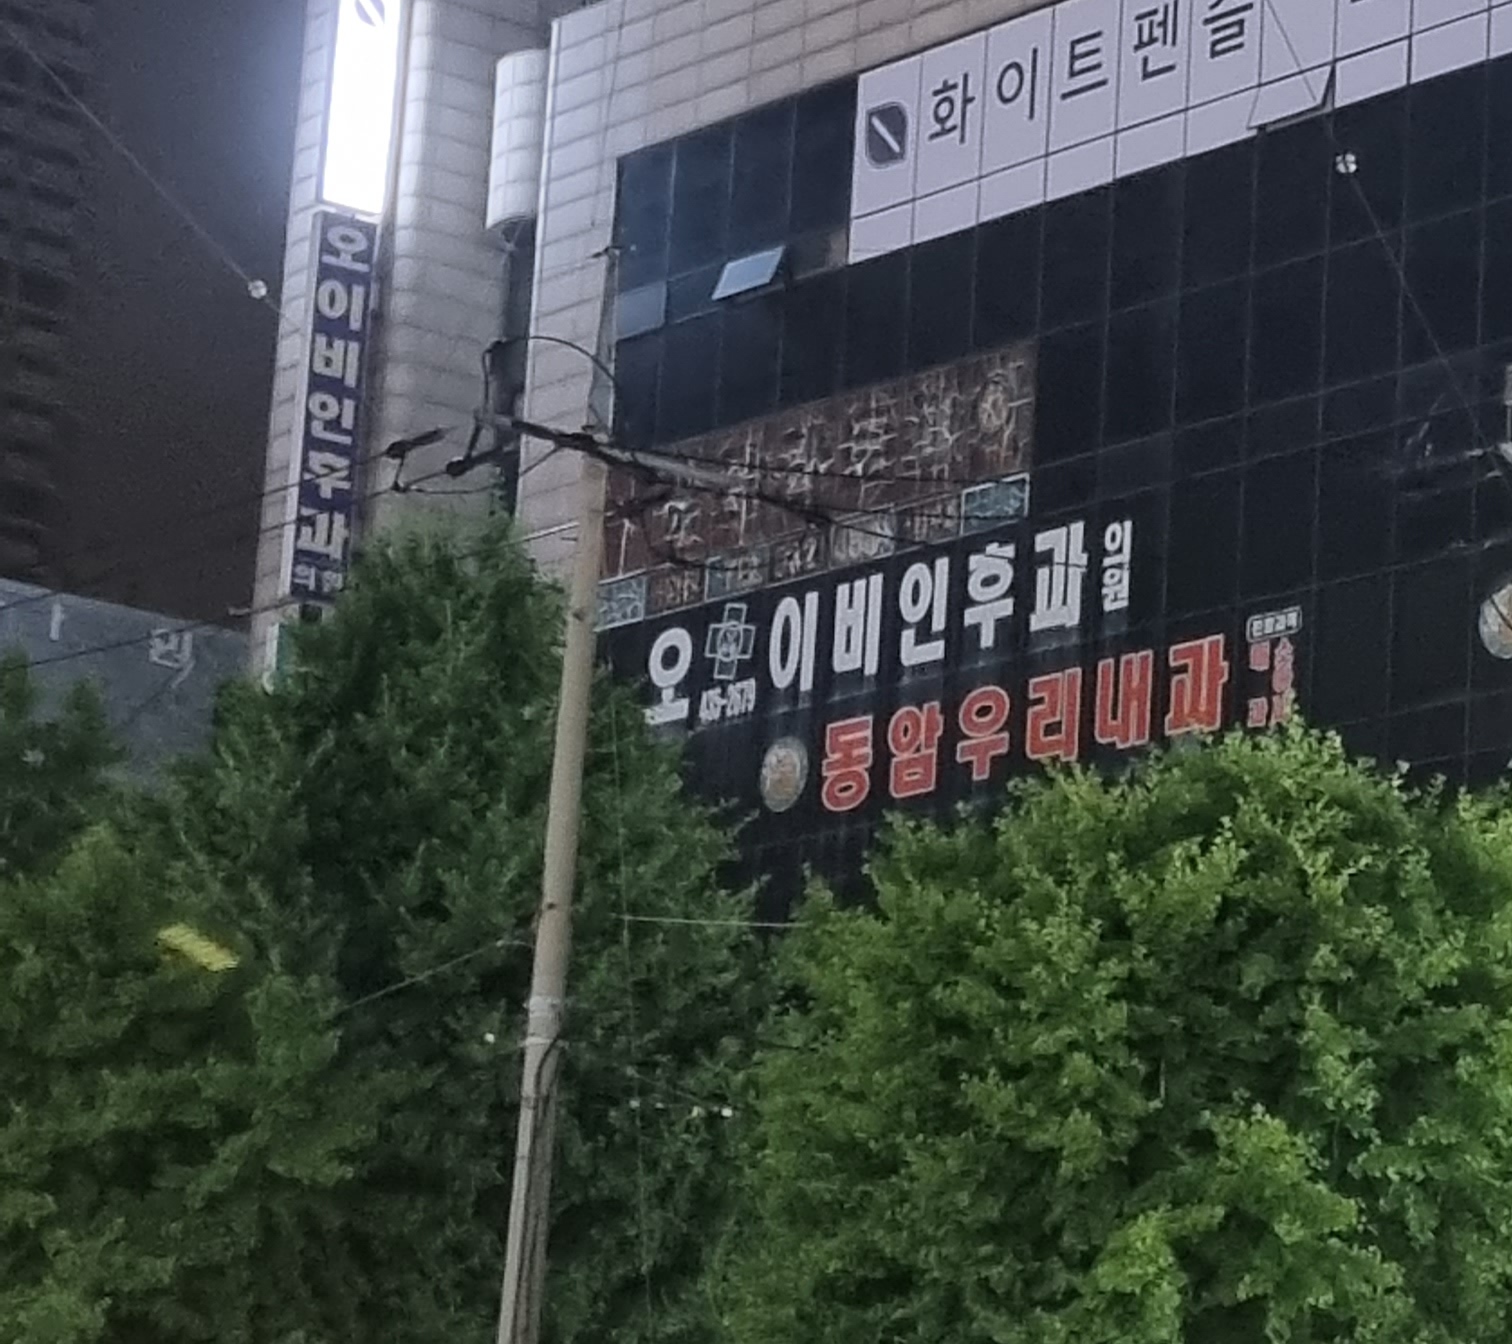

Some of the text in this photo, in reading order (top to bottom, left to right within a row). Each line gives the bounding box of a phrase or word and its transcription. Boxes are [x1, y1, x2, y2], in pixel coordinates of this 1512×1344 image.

[296, 224, 372, 560] 오이비인후과
[768, 520, 1086, 693] 이비인후과
[1102, 519, 1133, 612] 의원
[820, 633, 1230, 812] 동암우리내과
